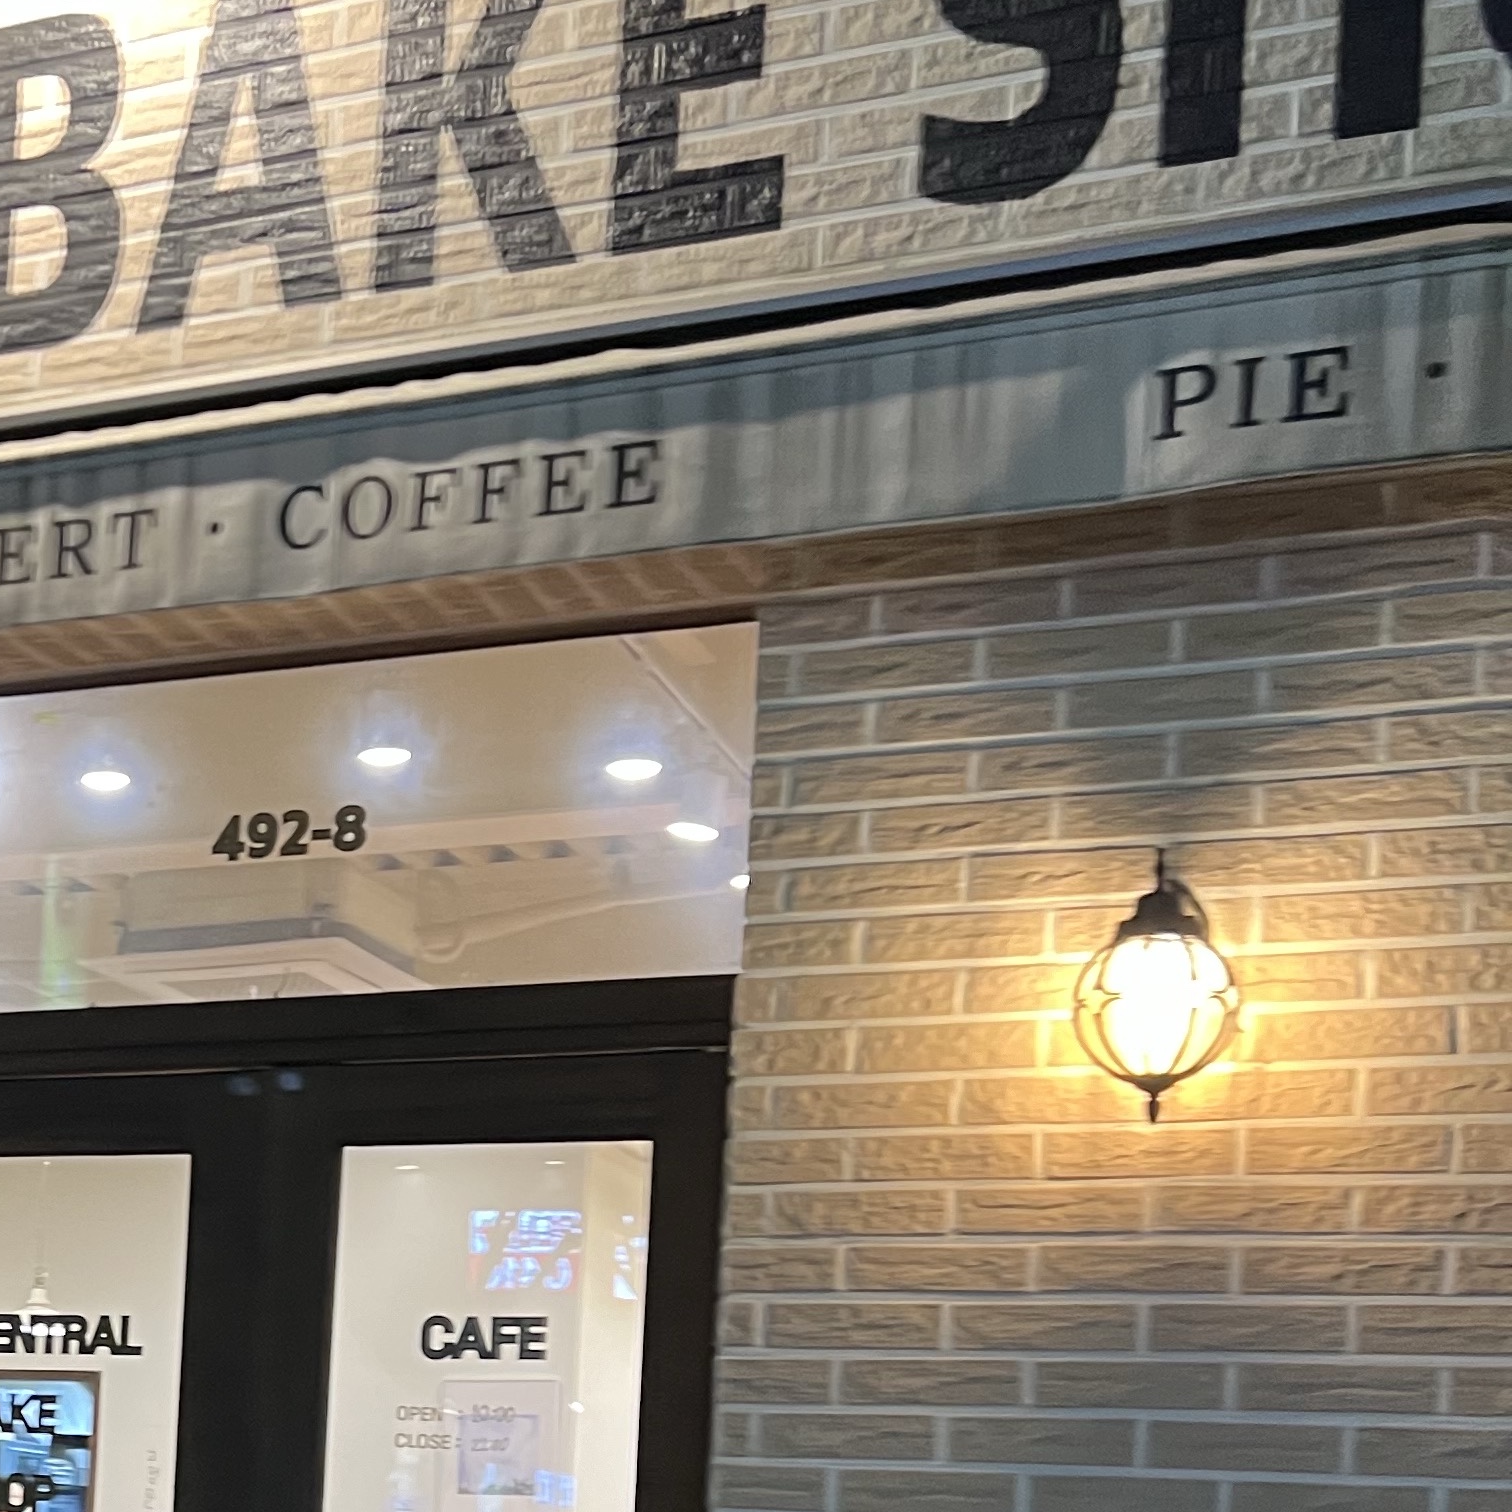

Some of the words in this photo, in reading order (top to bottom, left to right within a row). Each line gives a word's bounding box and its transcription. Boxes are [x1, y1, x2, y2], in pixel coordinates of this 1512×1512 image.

[1152, 345, 1355, 442] PIE
[279, 439, 663, 550] COFFEE
[211, 804, 366, 861] 492-8
[421, 1315, 549, 1360] CAFE
